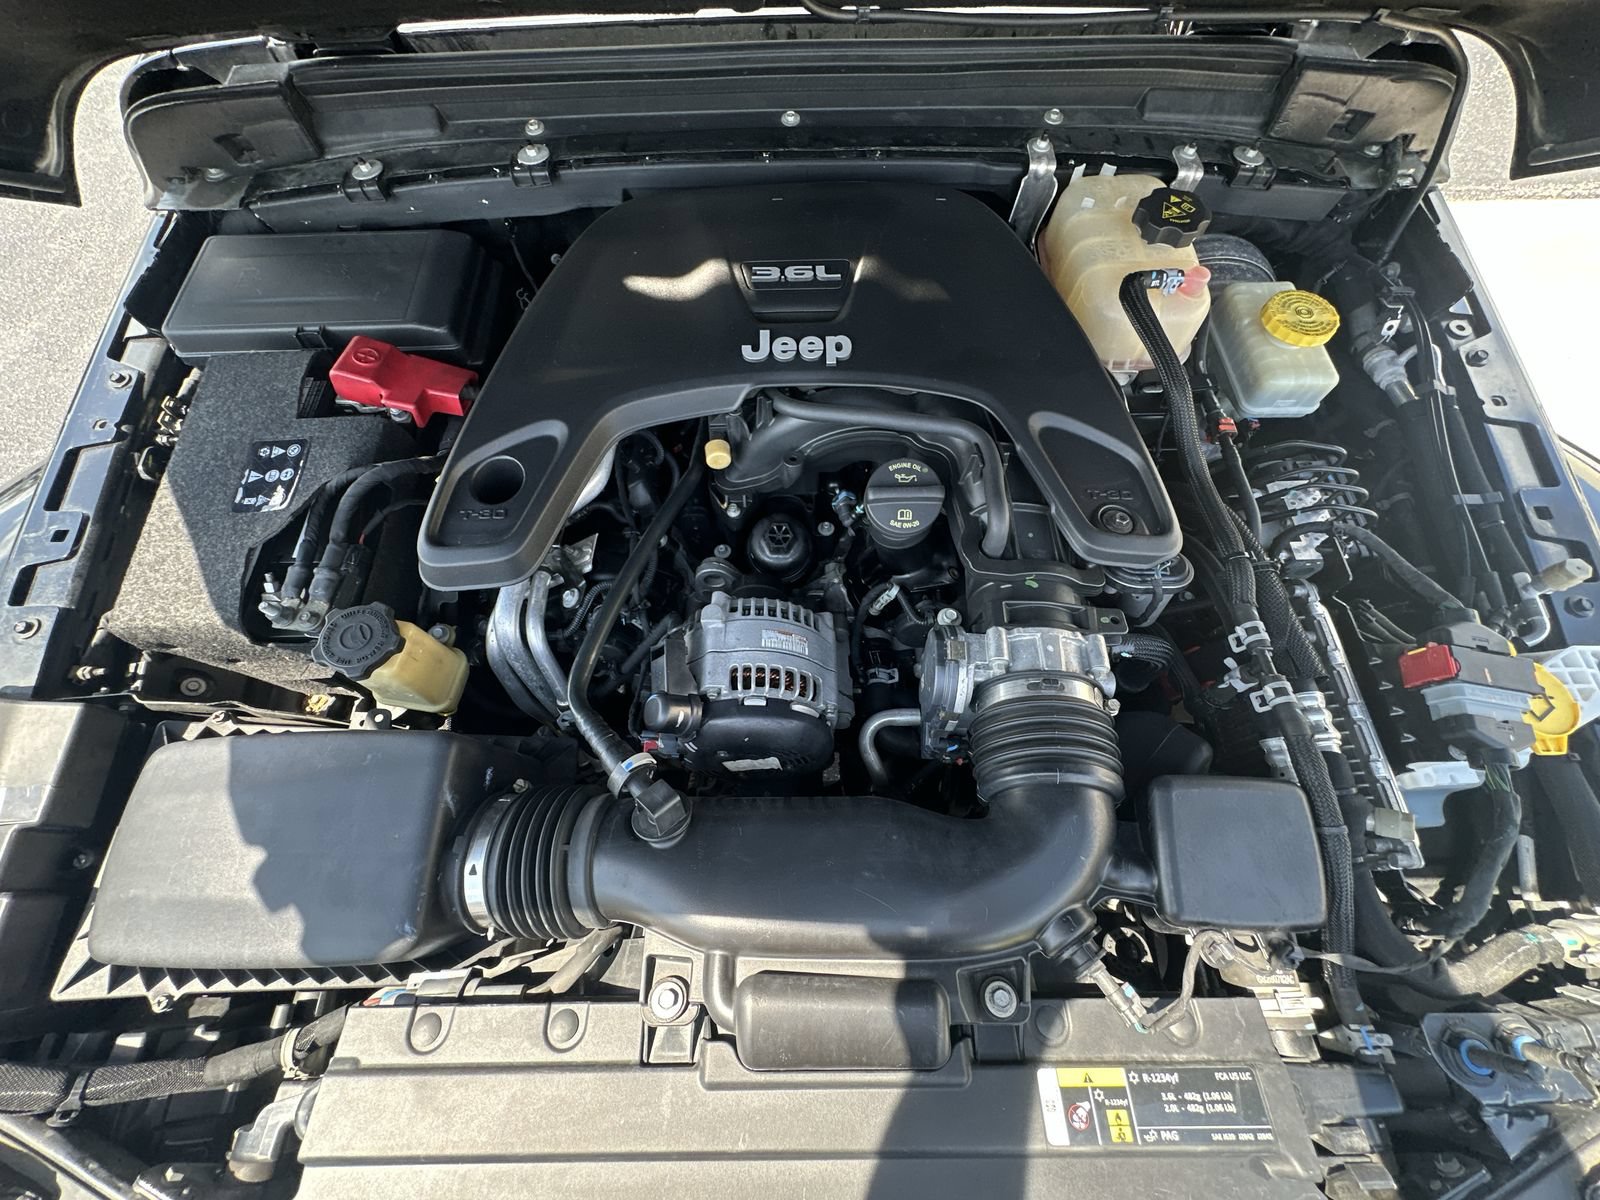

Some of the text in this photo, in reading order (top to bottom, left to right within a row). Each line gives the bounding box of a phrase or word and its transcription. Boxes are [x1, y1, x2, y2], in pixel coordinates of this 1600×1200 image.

[751, 265, 842, 282] 3.6L
[741, 329, 853, 366] Jeep
[888, 462, 922, 472] ENGINE OIL
[889, 520, 920, 529] SAE 0W-20
[1141, 1072, 1180, 1085] R-1234yf
[1214, 1071, 1253, 1081] FCA US LLC
[1160, 1092, 1177, 1101] 3.6L
[1164, 1103, 1180, 1113] 2.0L
[1160, 1131, 1180, 1141] PAG
